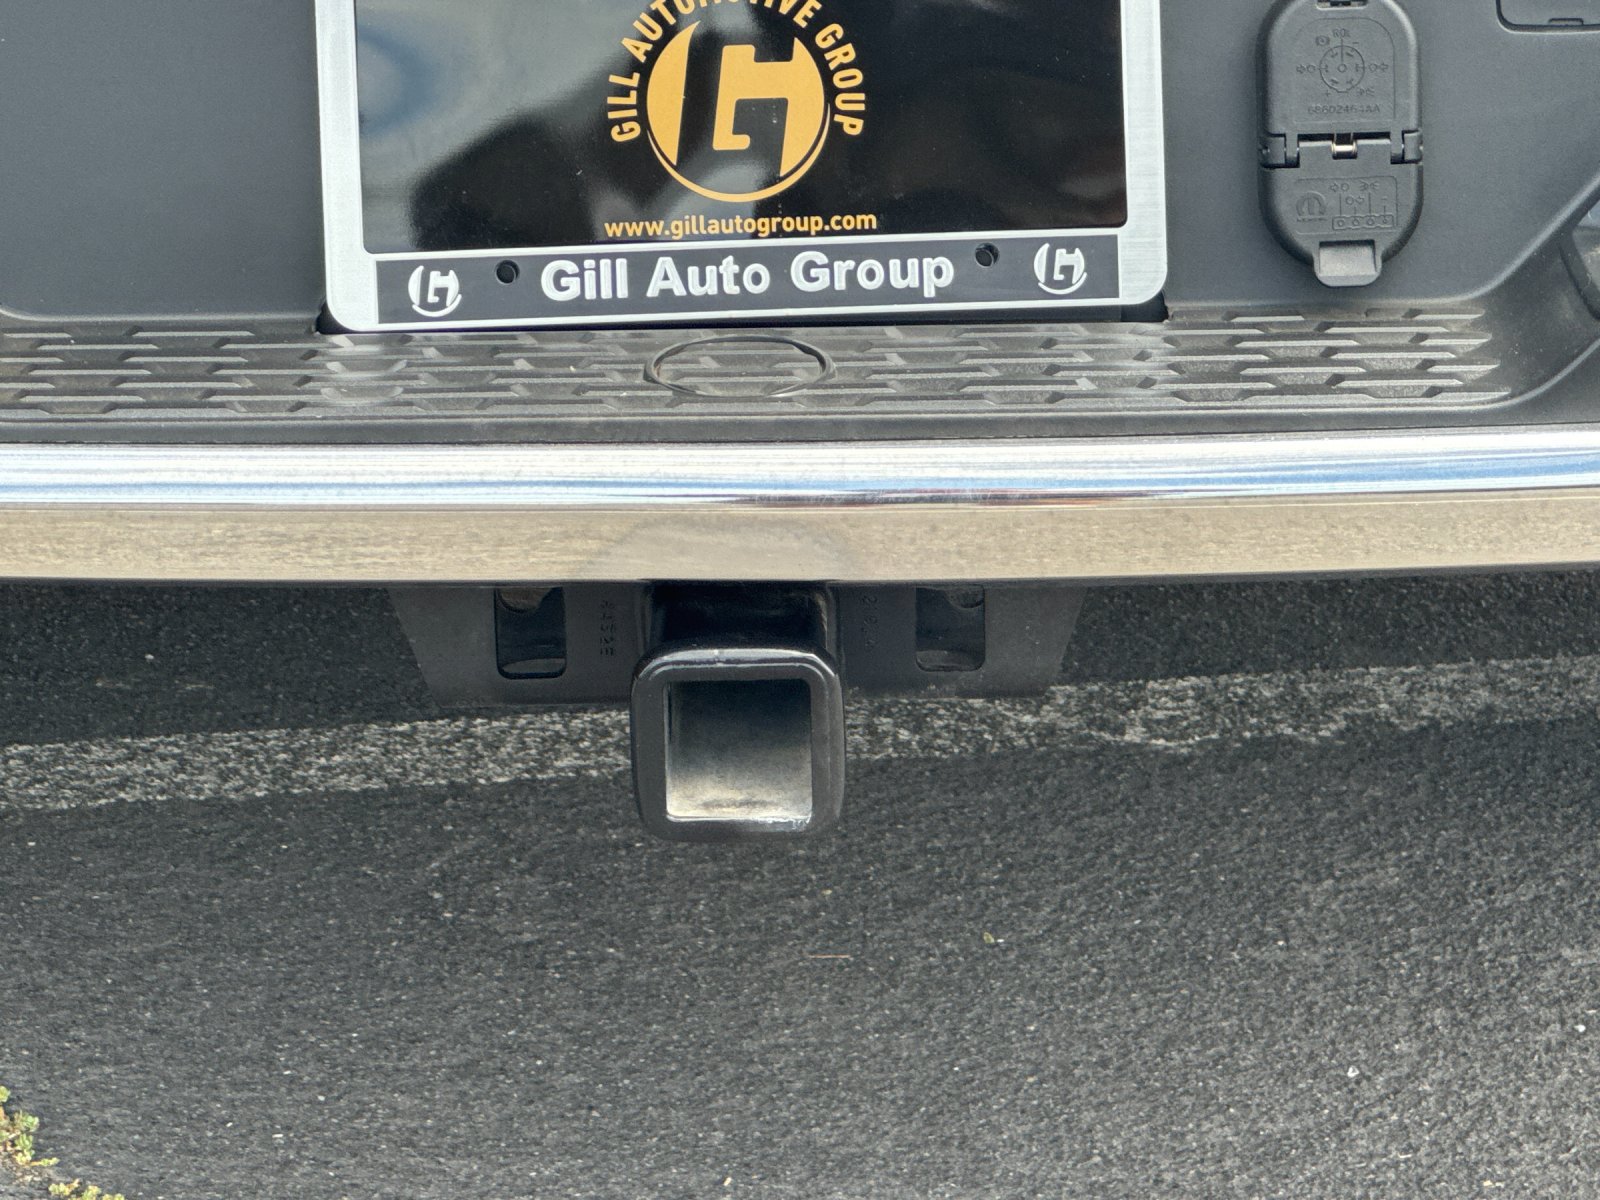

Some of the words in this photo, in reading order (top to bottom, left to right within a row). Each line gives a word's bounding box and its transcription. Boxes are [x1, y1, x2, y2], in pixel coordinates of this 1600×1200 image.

[621, 0, 822, 63] AUTOVE
[607, 71, 641, 142] GILL
[814, 23, 866, 136] GROUP
[604, 213, 877, 240] www.gillautogroup.com
[540, 258, 629, 301] Gill
[646, 255, 771, 297] Auto
[790, 250, 955, 298] Group
